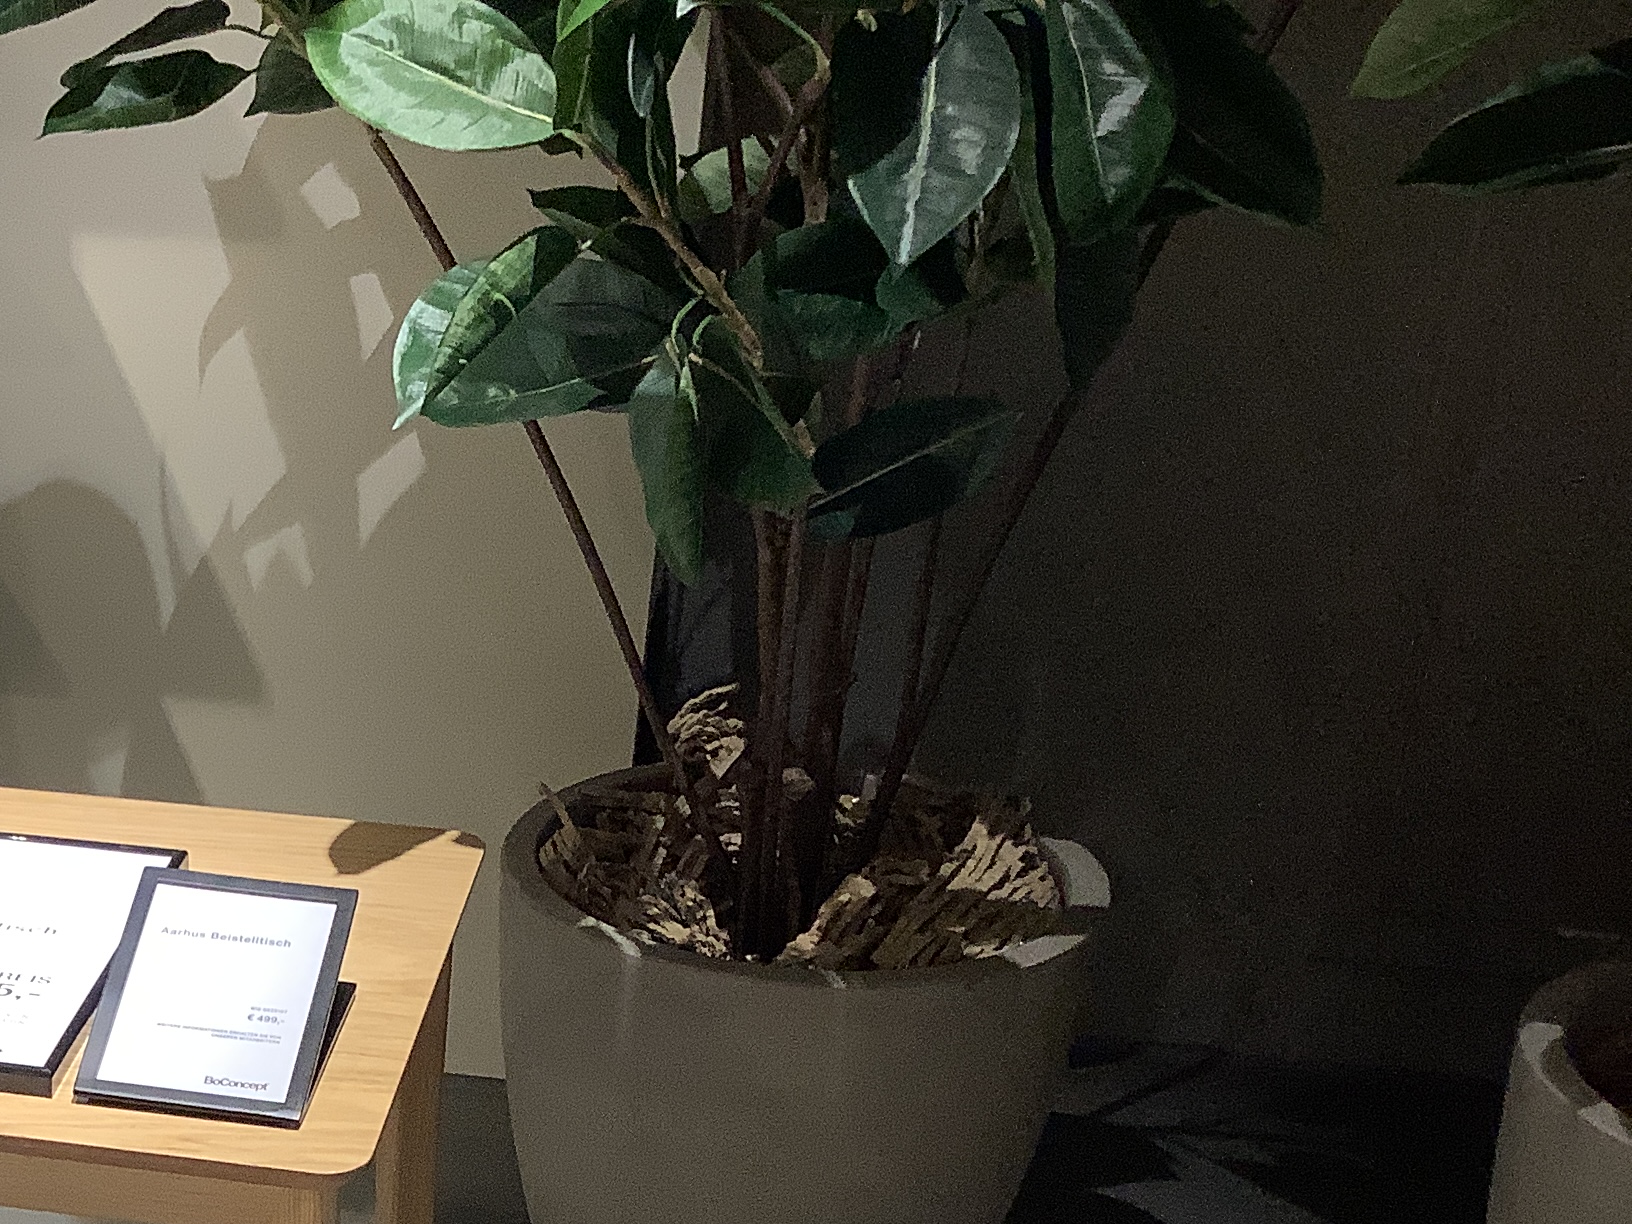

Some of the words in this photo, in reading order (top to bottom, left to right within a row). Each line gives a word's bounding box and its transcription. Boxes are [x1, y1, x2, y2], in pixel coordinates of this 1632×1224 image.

[161, 926, 206, 939] Aarhus
[210, 931, 292, 948] Beistelltisch
[257, 1014, 285, 1026] 499,-
[204, 1075, 269, 1092] BoConcept
